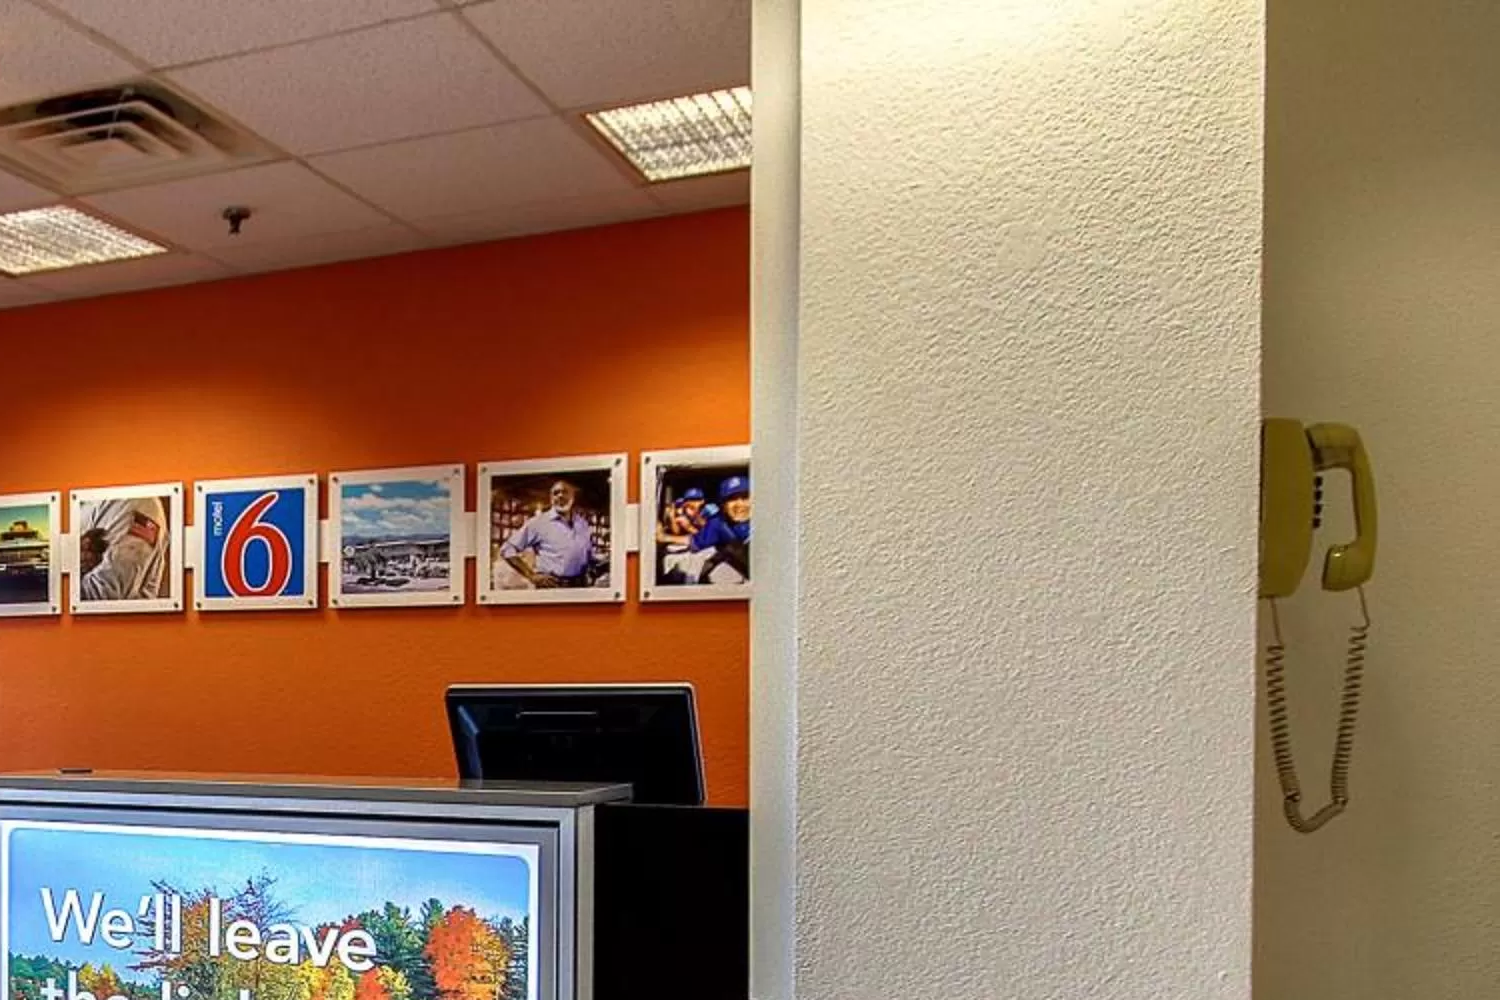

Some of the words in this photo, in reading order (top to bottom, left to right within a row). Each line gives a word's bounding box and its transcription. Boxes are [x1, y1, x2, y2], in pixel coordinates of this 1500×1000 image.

[211, 501, 223, 536] motel
[221, 491, 292, 599] 6
[40, 887, 183, 949] We'll
[209, 897, 378, 971] leave
